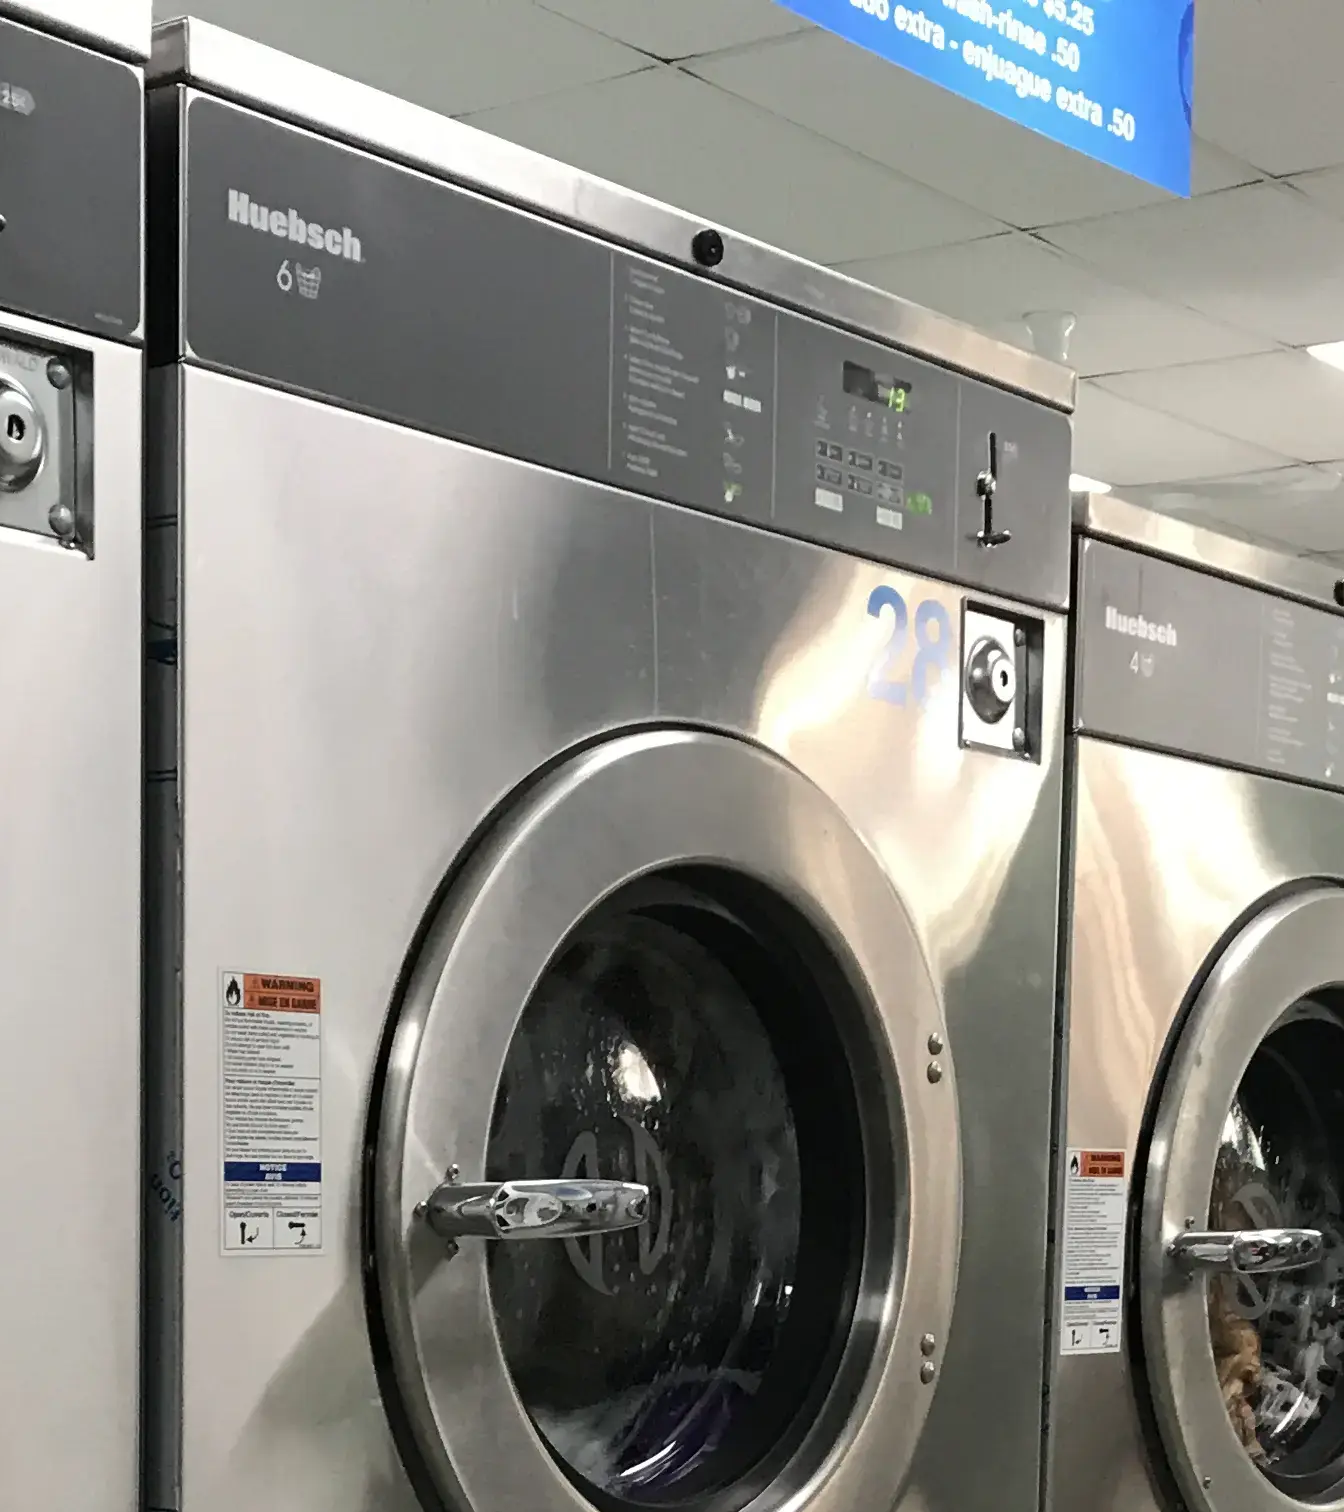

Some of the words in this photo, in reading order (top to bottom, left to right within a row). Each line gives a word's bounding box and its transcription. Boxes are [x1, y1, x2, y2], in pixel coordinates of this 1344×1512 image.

[894, 5, 945, 50] extra
[962, 38, 1052, 102] enjuague
[1056, 83, 1103, 127] extra
[1107, 107, 1135, 141] .50
[228, 187, 362, 262] Huebsch
[277, 259, 293, 292] 6
[867, 585, 954, 708] 28
